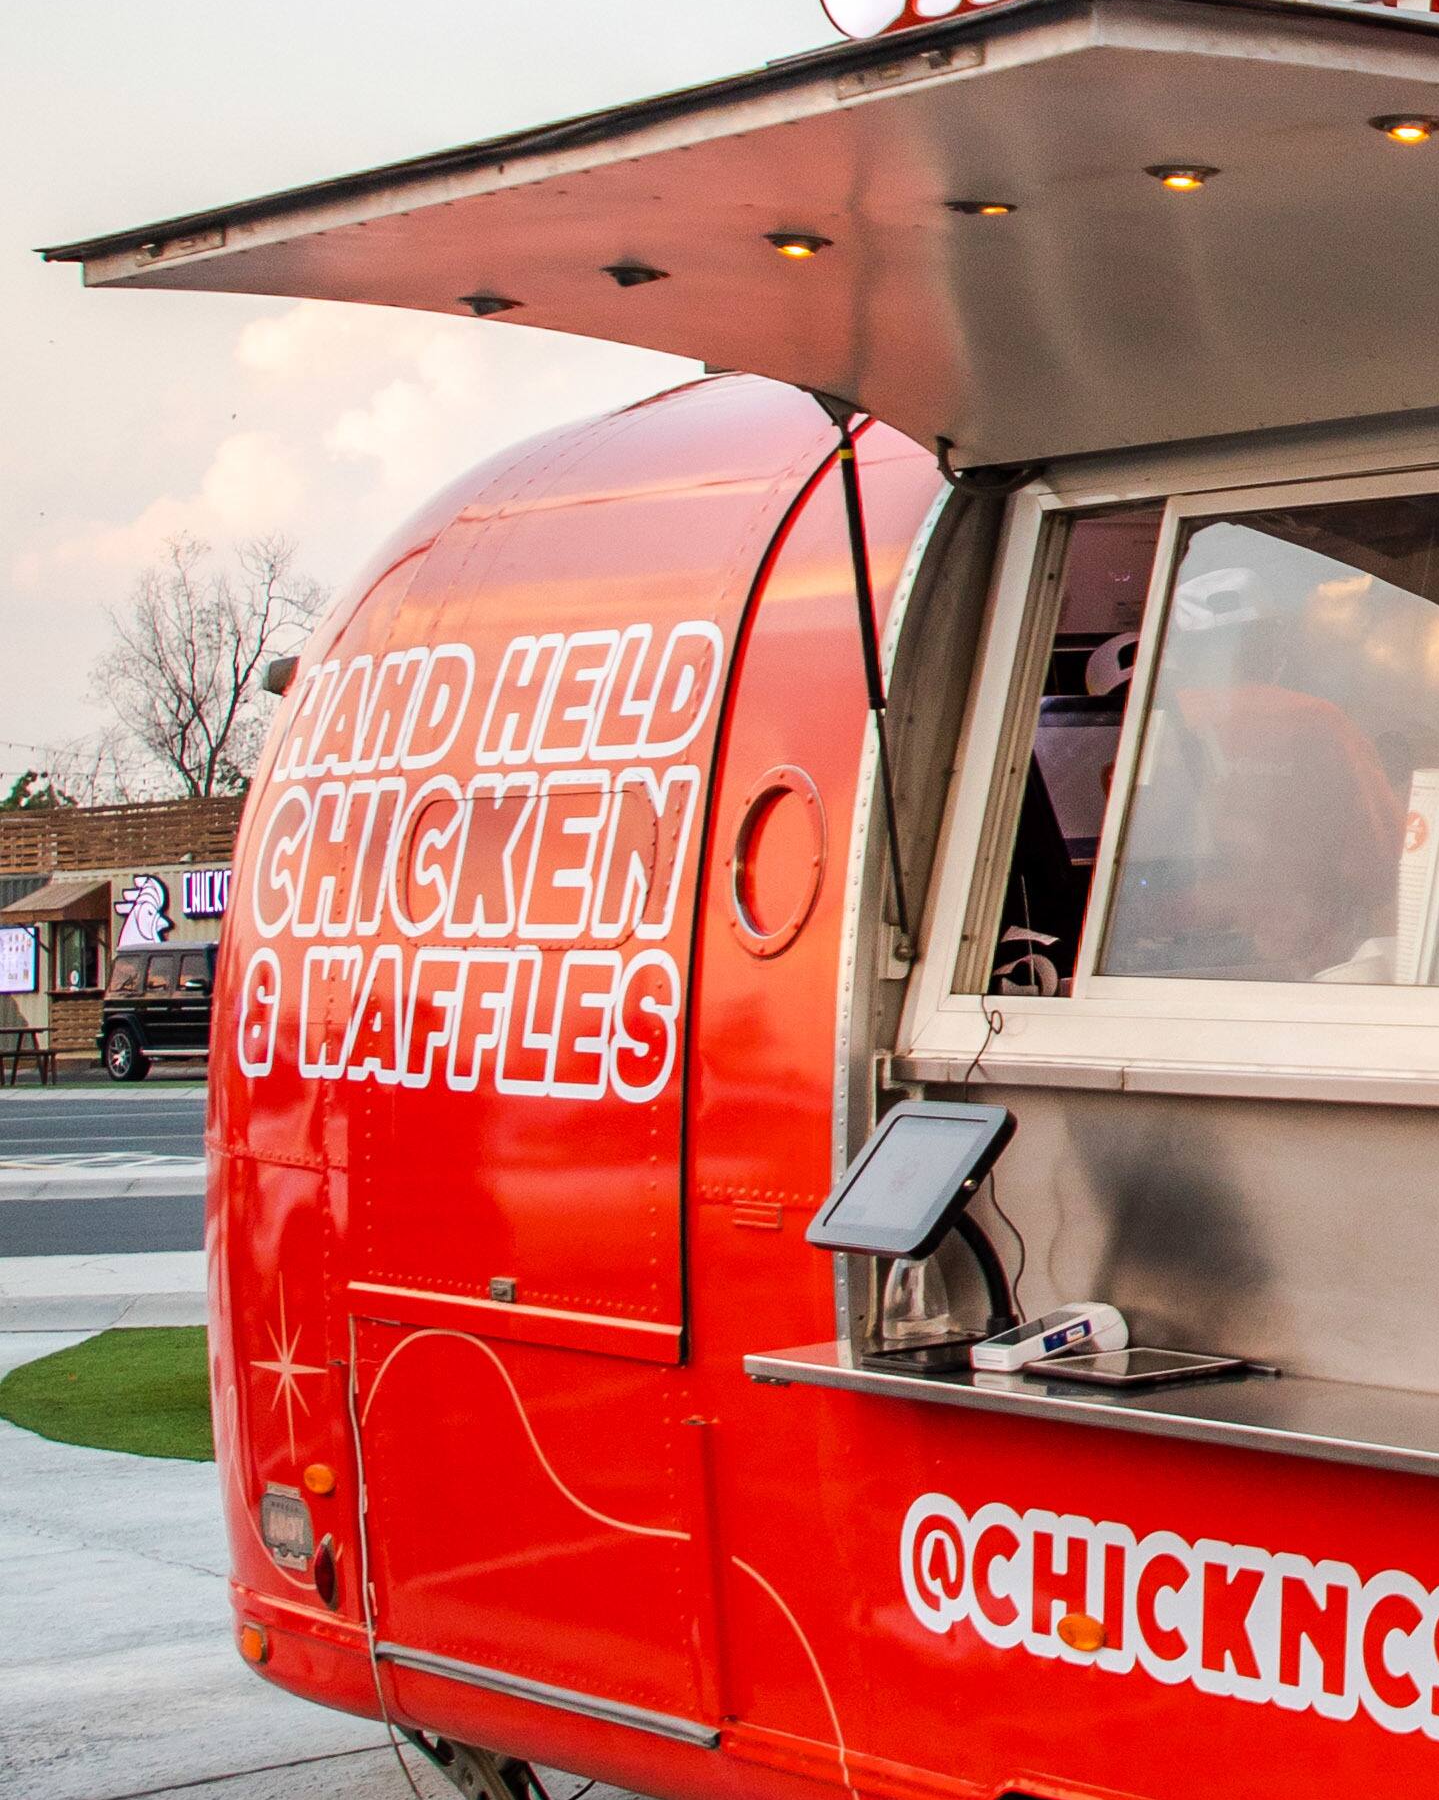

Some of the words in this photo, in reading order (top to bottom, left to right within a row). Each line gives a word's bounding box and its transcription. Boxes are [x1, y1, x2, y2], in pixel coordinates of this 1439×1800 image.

[273, 642, 476, 782] HAND
[476, 620, 724, 767] HELD
[253, 765, 700, 940] CHICKEN
[238, 947, 282, 1079] &
[299, 944, 681, 1103] WAFFLES
